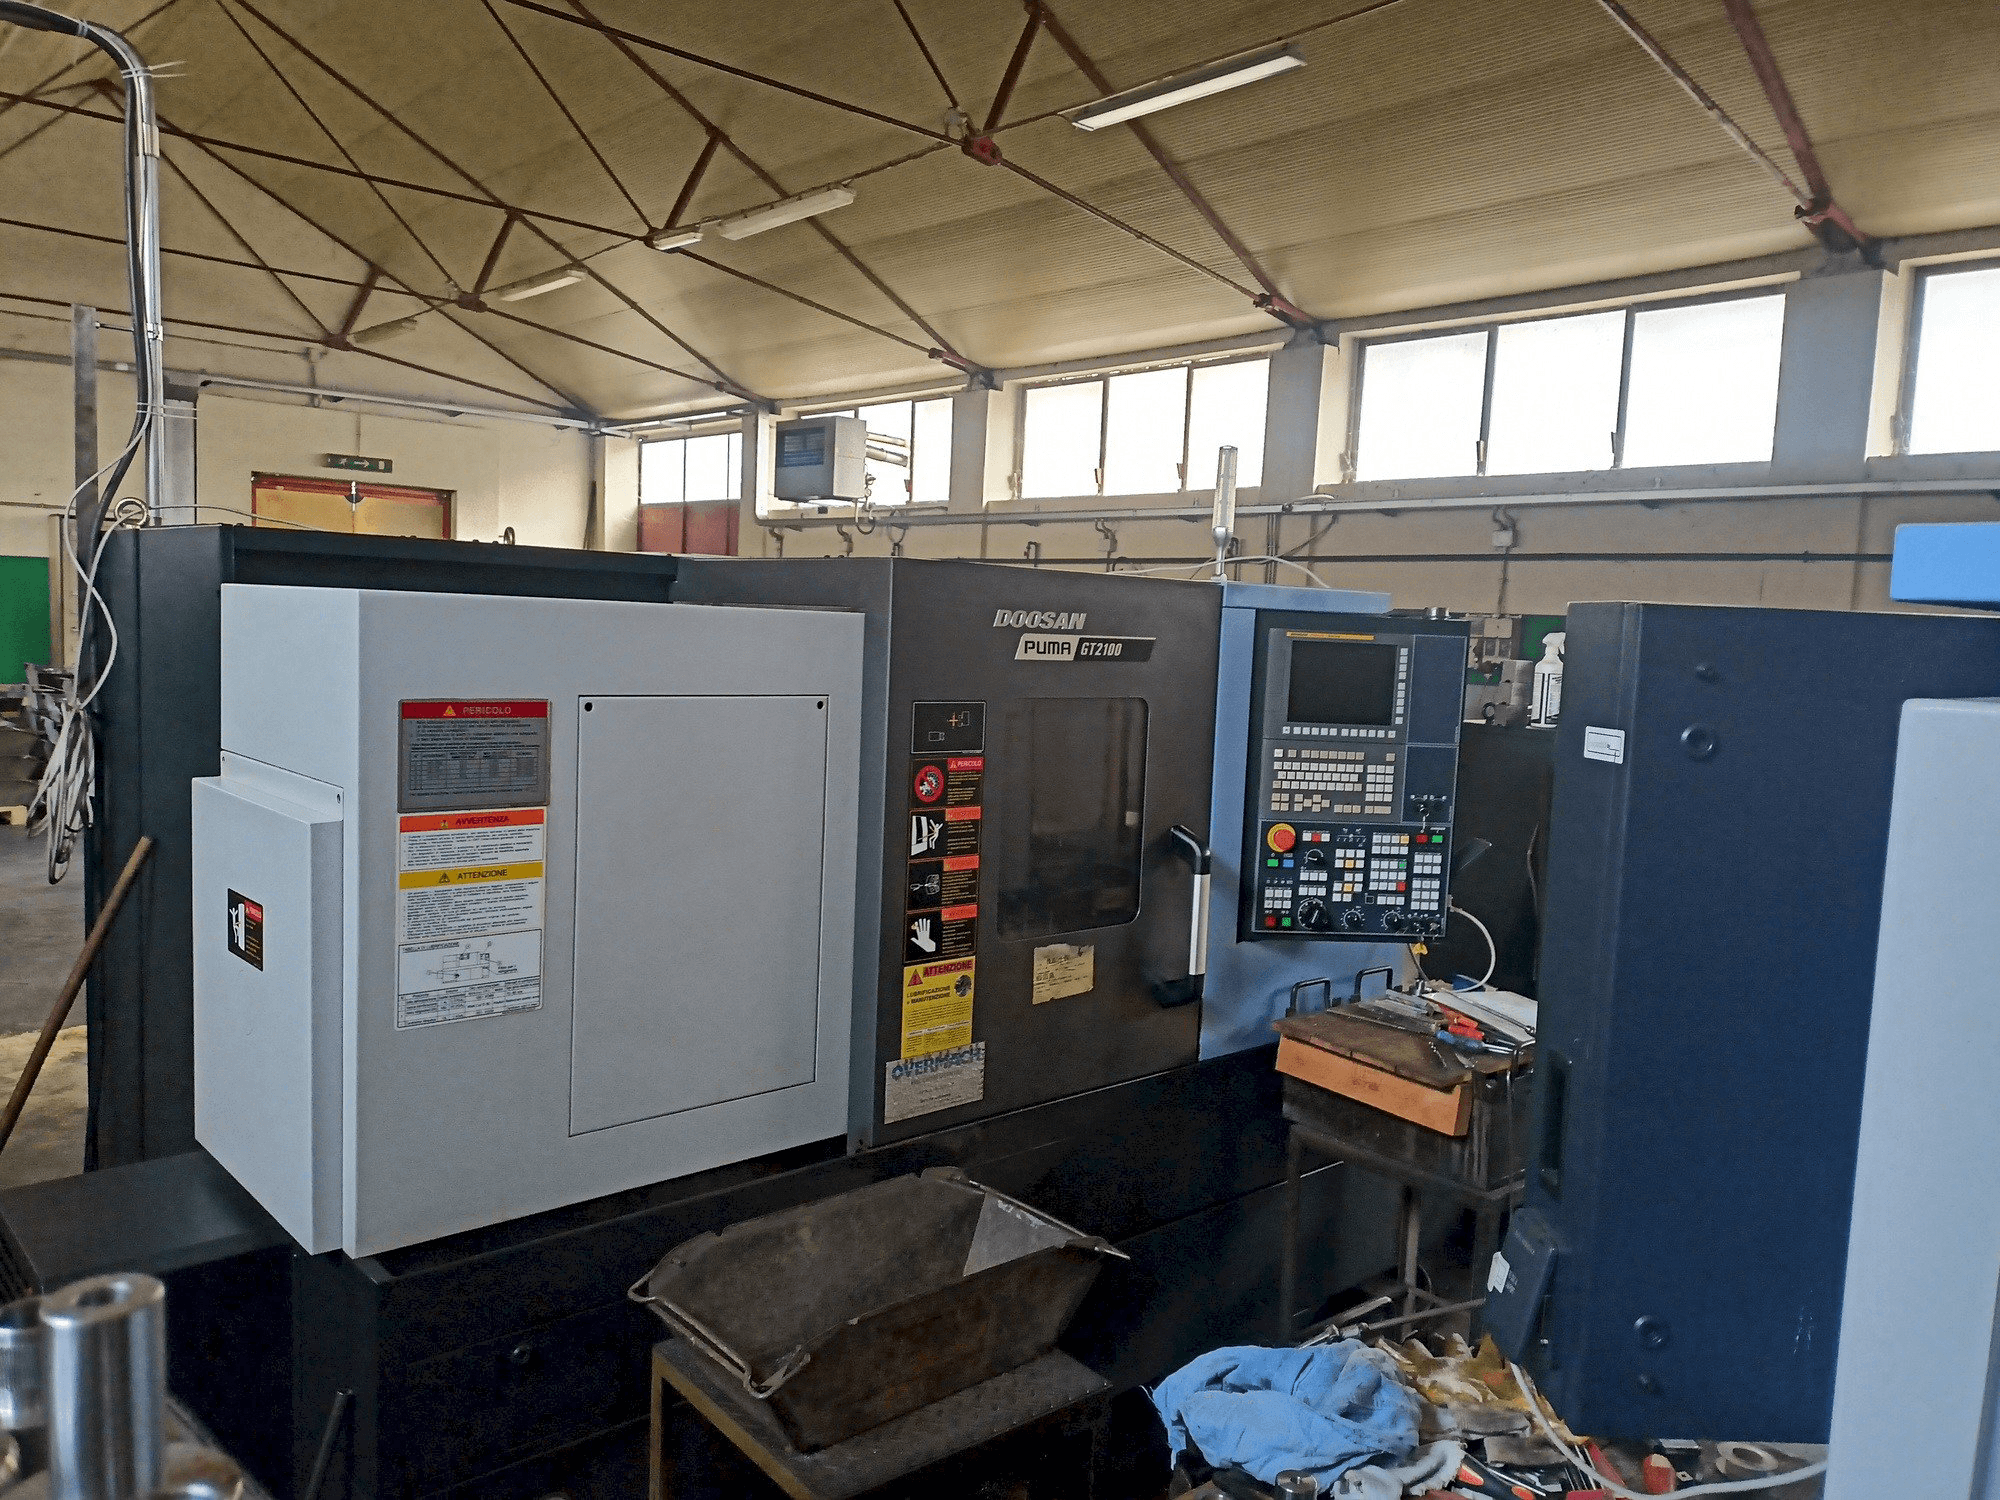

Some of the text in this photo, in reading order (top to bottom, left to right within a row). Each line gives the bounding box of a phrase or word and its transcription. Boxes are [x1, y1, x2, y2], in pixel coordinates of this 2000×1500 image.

[993, 609, 1087, 630] DOOSAN
[1023, 640, 1123, 656] PUMA GT2100
[462, 705, 512, 715] PERICOLO
[455, 815, 511, 826] AVVERTENZA
[456, 868, 508, 881] ATTENZIONE
[922, 959, 974, 978] ATTENZIONE
